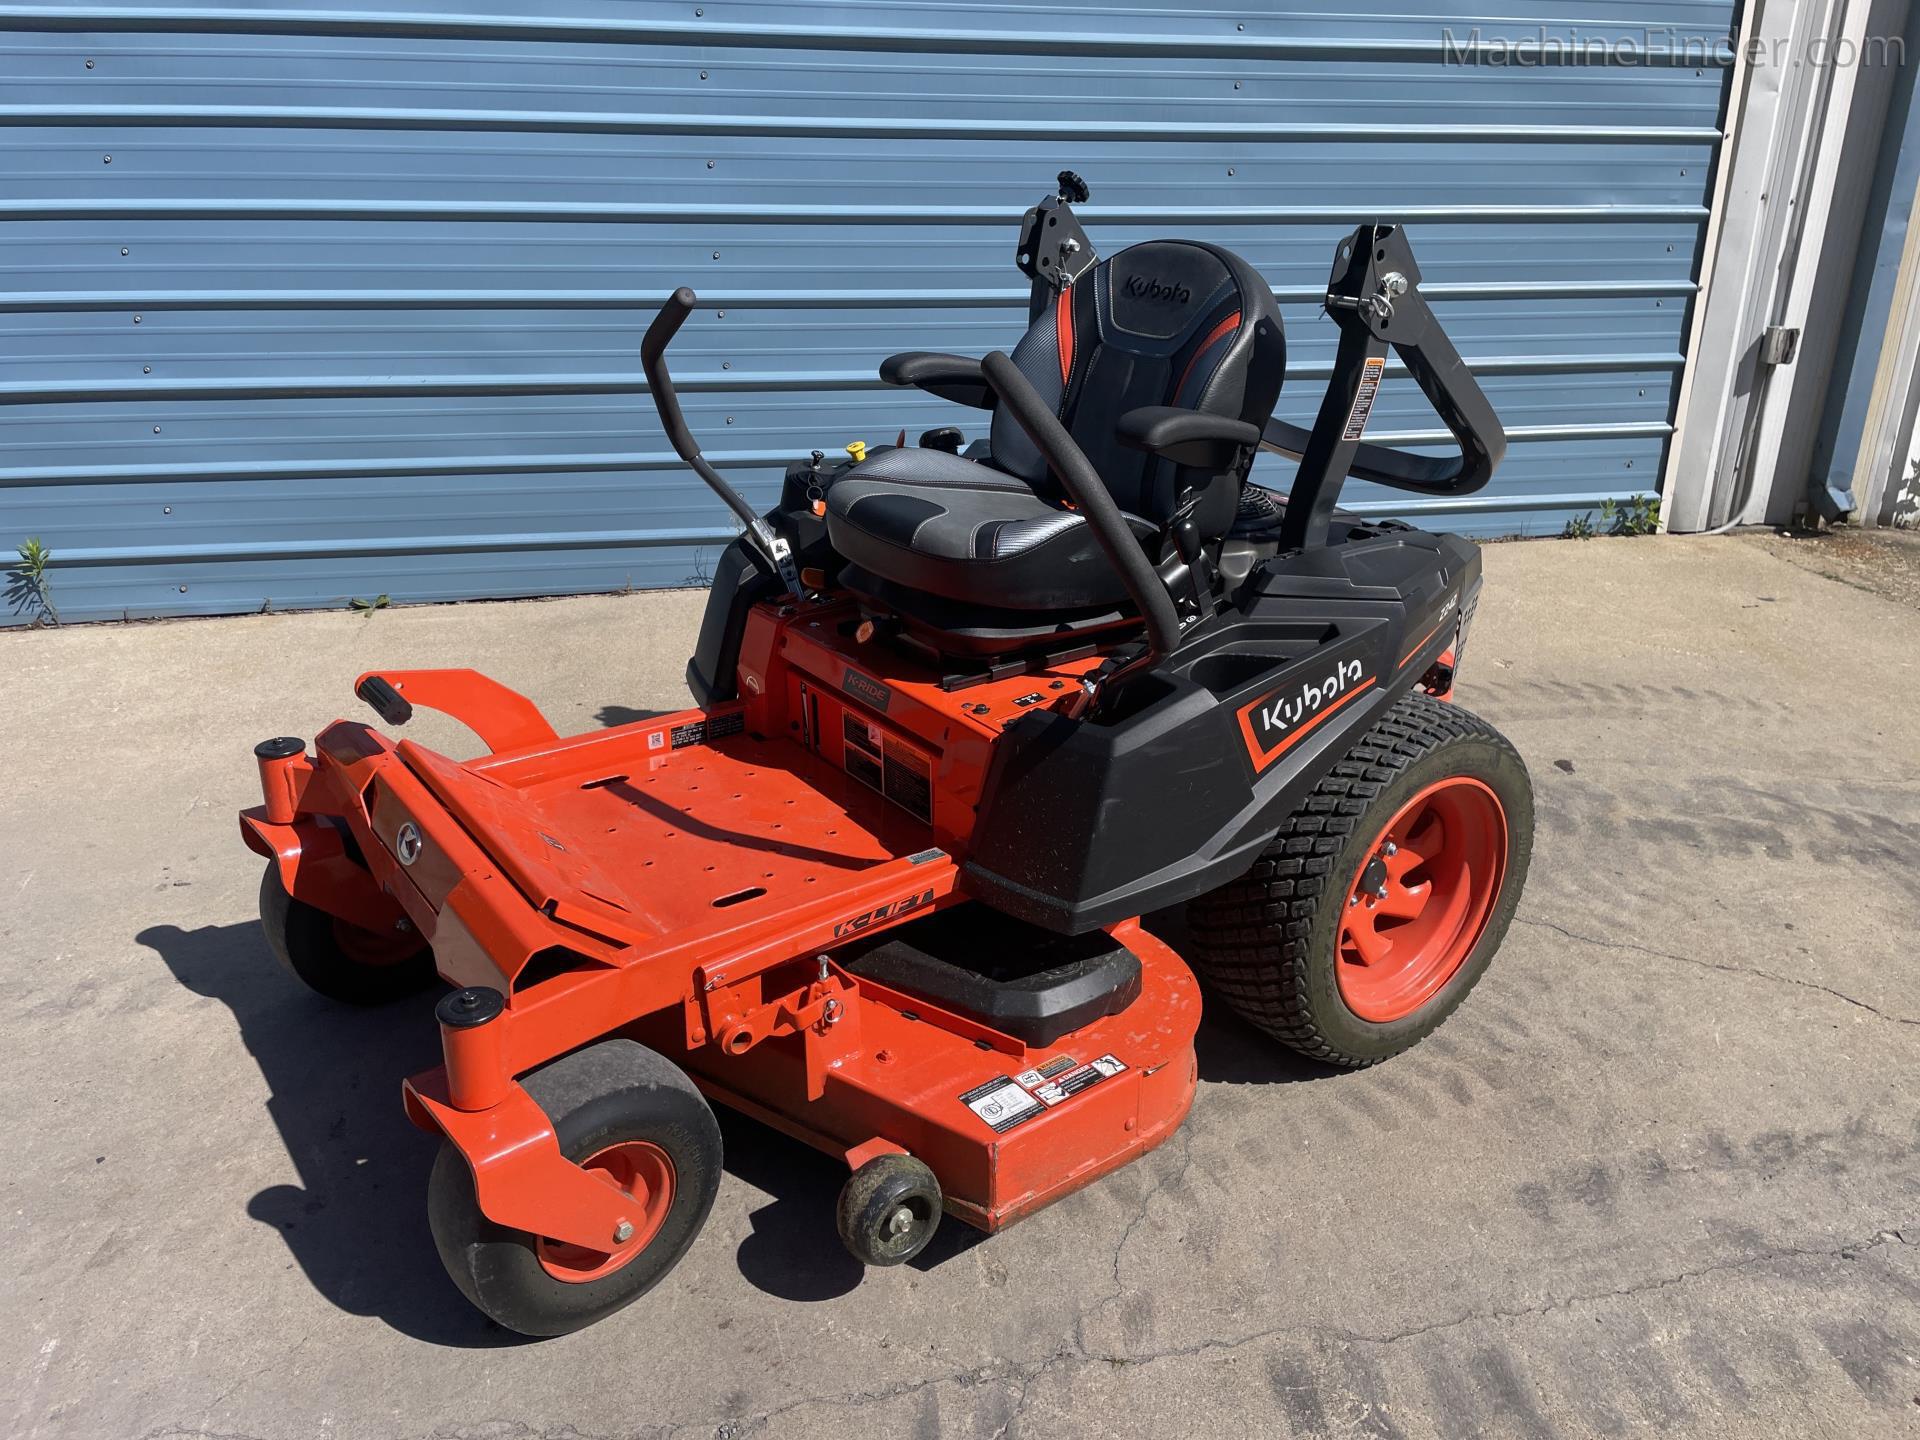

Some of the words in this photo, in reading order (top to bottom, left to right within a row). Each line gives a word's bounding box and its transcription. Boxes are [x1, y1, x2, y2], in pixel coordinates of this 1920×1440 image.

[1125, 275, 1190, 304] Kubota
[1262, 659, 1363, 731] Kubota
[836, 889, 933, 938] K-LIFT
[1062, 1064, 1091, 1080] DANGER
